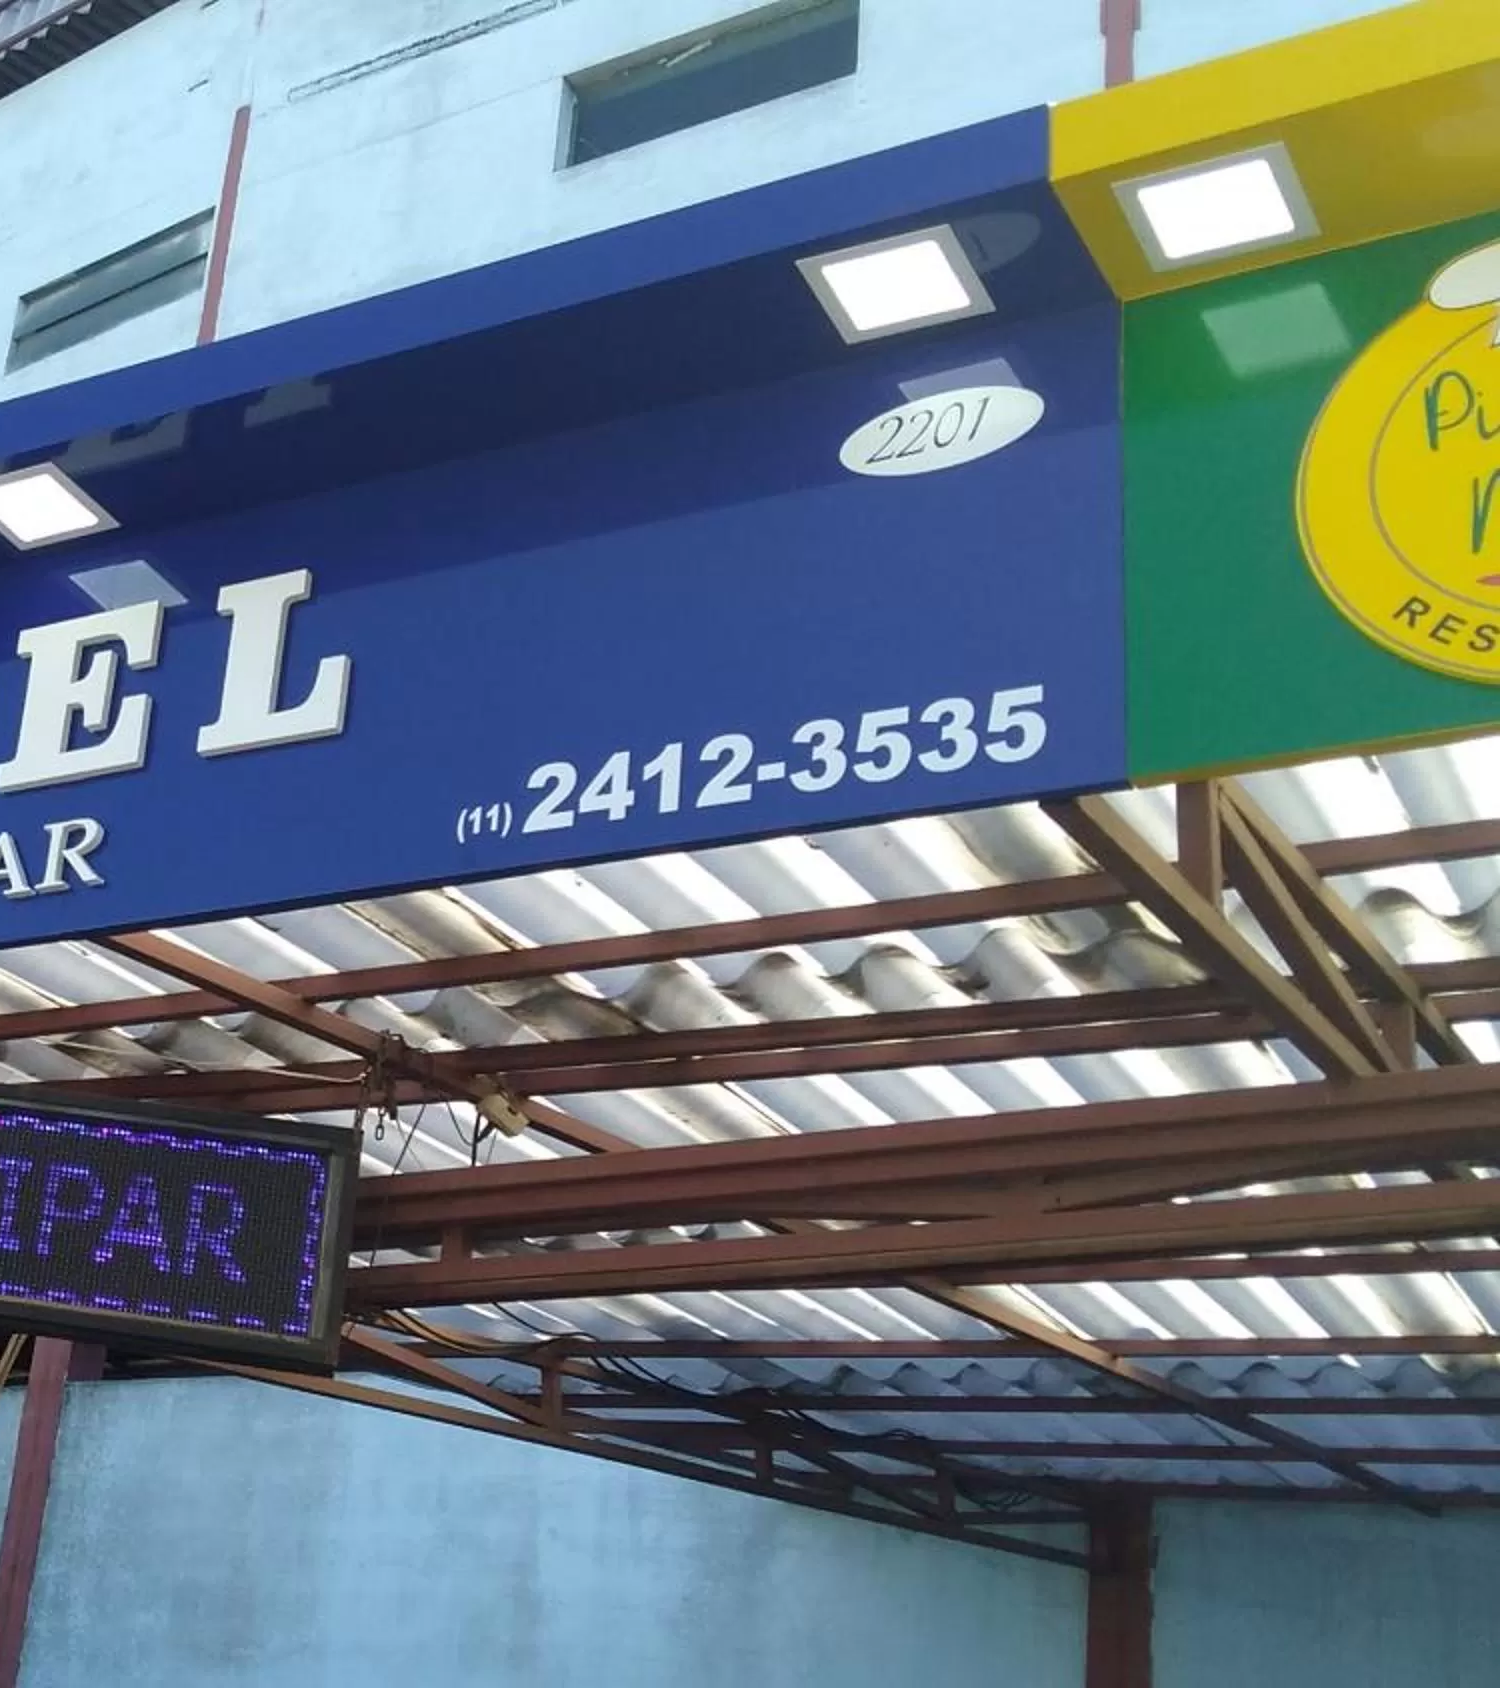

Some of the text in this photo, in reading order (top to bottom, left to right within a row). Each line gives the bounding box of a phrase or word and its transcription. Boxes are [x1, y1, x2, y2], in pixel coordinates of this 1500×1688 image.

[865, 396, 993, 466] 2201
[456, 684, 1047, 843] (11) 2412-3535
